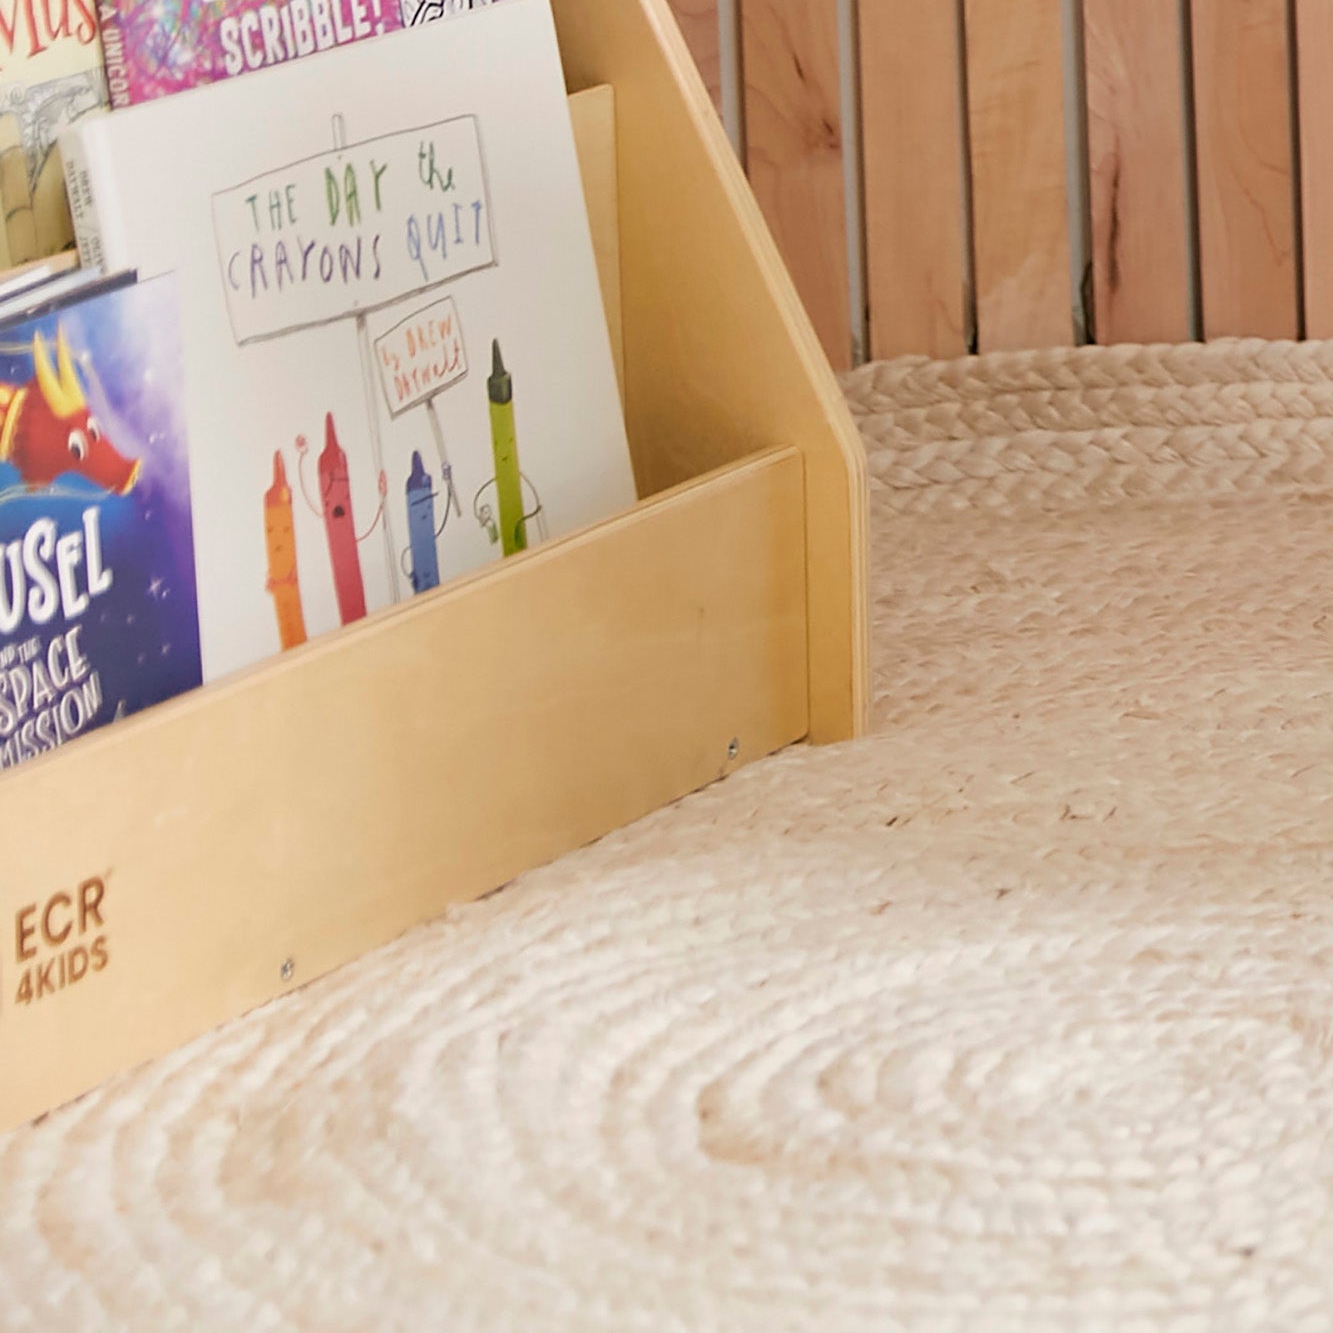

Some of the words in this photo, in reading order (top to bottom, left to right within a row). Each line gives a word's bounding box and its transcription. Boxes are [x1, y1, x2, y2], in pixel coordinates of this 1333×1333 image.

[246, 182, 298, 234] THE
[324, 159, 389, 229] DAY
[417, 140, 456, 194] the
[227, 233, 382, 300] CRAYONS
[406, 199, 482, 283] QUIT
[15, 876, 105, 964] ECR
[14, 934, 109, 1007] 4KIDS
